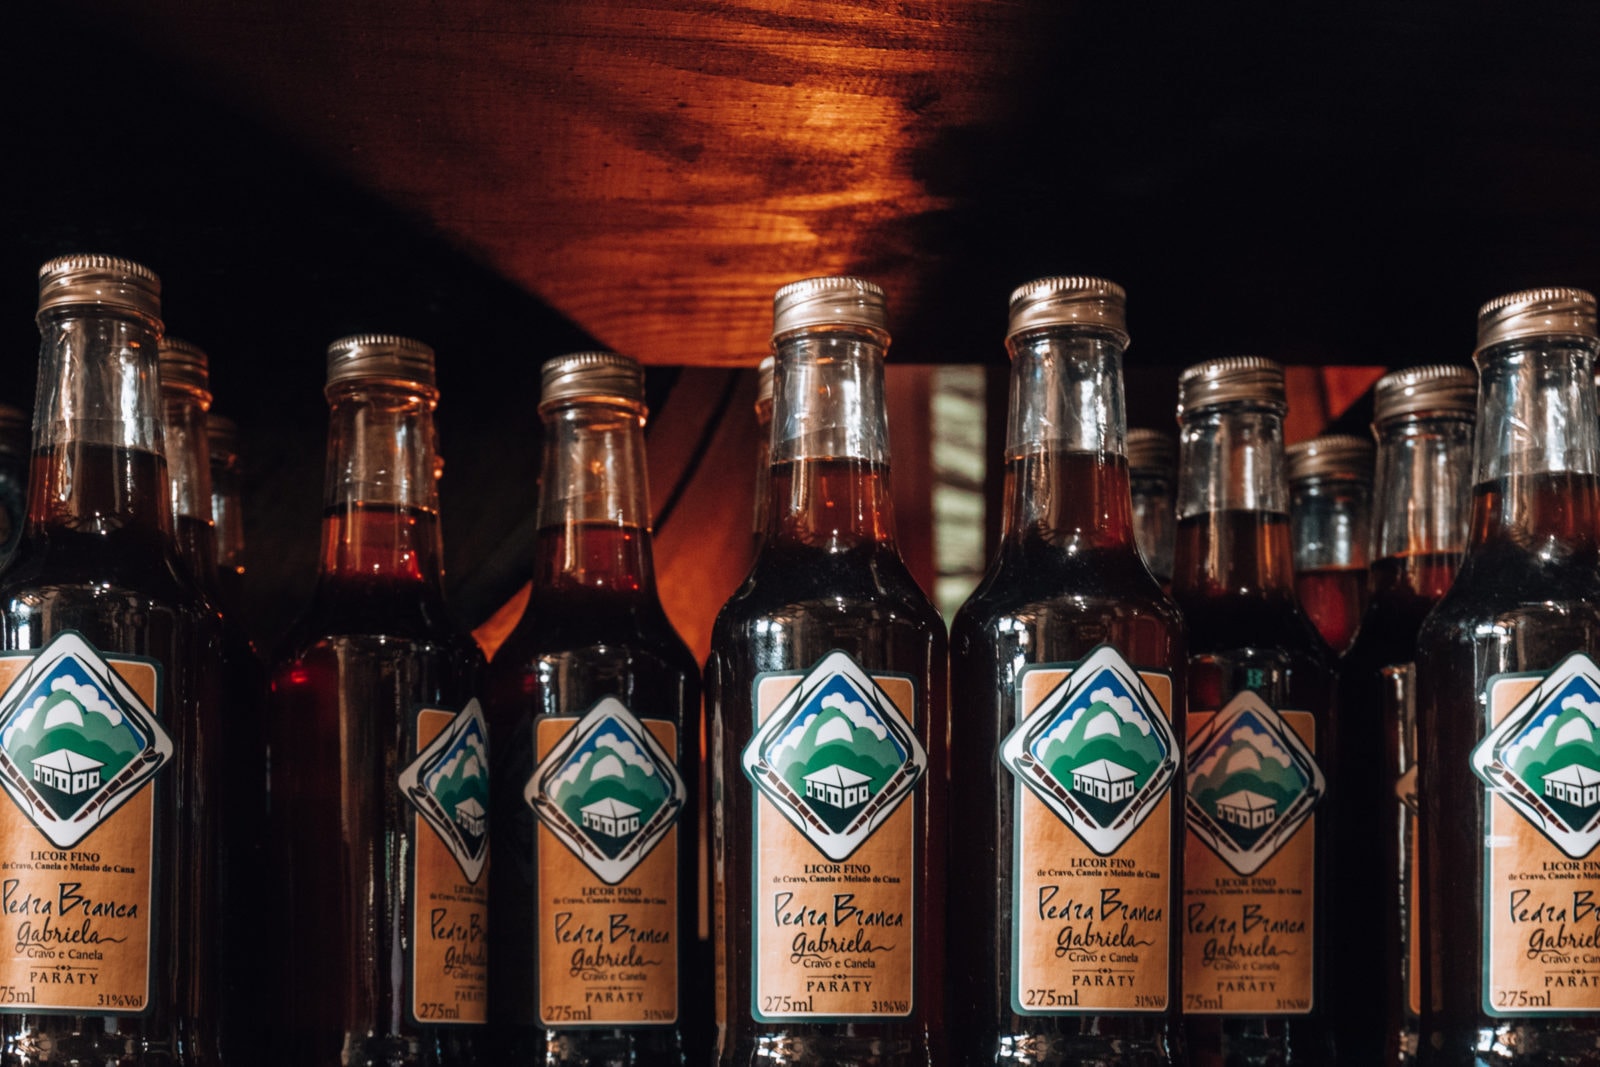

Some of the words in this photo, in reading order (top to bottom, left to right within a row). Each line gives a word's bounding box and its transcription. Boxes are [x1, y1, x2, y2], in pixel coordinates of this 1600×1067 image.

[30, 851, 67, 861] LICOR
[70, 852, 100, 863] FINO
[10, 862, 33, 871] Cravo,
[70, 863, 100, 872] Melado
[102, 864, 112, 872] de
[113, 865, 135, 874] Cana
[1071, 858, 1107, 868] LICOR
[1110, 858, 1135, 868] FINO
[1543, 862, 1580, 871] LICOR
[1583, 862, 1600, 871] FIN
[804, 865, 841, 874] LICOR
[844, 865, 870, 874] FINO
[1048, 869, 1074, 878] Cravo,
[1076, 869, 1102, 877] Canela
[1136, 870, 1144, 878] de
[783, 876, 807, 884] Cravo,
[809, 875, 835, 883] Canela
[844, 875, 871, 883] Melado
[873, 875, 881, 883] de
[1520, 873, 1546, 881] Cravo,
[1548, 872, 1575, 880] Canela
[1215, 878, 1248, 887] LICOR
[1251, 878, 1276, 887] FINO
[582, 888, 614, 896] LICOR
[617, 888, 642, 896] FINO
[3, 879, 51, 916] Pedra
[59, 882, 137, 918] Branca
[1038, 885, 1094, 921] Pedra
[1100, 888, 1162, 922] Branca
[774, 892, 827, 927] Pedra
[833, 894, 903, 927] Branca
[1510, 889, 1566, 923] Pedra
[1187, 902, 1236, 934] Pedra
[1242, 904, 1305, 934] Branca
[555, 912, 603, 944] Pedra
[609, 914, 669, 944] Branca
[27, 949, 55, 959] Cravo
[59, 951, 65, 959] e
[68, 949, 104, 960] Canela
[1069, 952, 1097, 962] Cravo
[1109, 952, 1138, 963] Canela
[1541, 954, 1570, 964] Cravo
[1583, 954, 1600, 963] Can
[803, 959, 832, 968] Cravo
[835, 960, 841, 968] e
[844, 958, 875, 968] Canela
[30, 971, 99, 985] PARATY
[582, 972, 606, 981] Cravo
[618, 972, 647, 981] Canela
[1072, 975, 1135, 986] PARATY
[1545, 976, 1600, 987] PARAT
[807, 981, 872, 992] PARATY
[1217, 982, 1276, 992] PARATY
[0, 986, 35, 1003] 75ml
[585, 992, 644, 1002] PARATY
[1026, 989, 1079, 1006] 275ml
[1498, 990, 1551, 1007] 275ml
[764, 995, 814, 1012] 275ml
[1186, 994, 1223, 1009] 75ml
[420, 1002, 460, 1019] 275ml
[545, 1006, 592, 1020] 275ml
